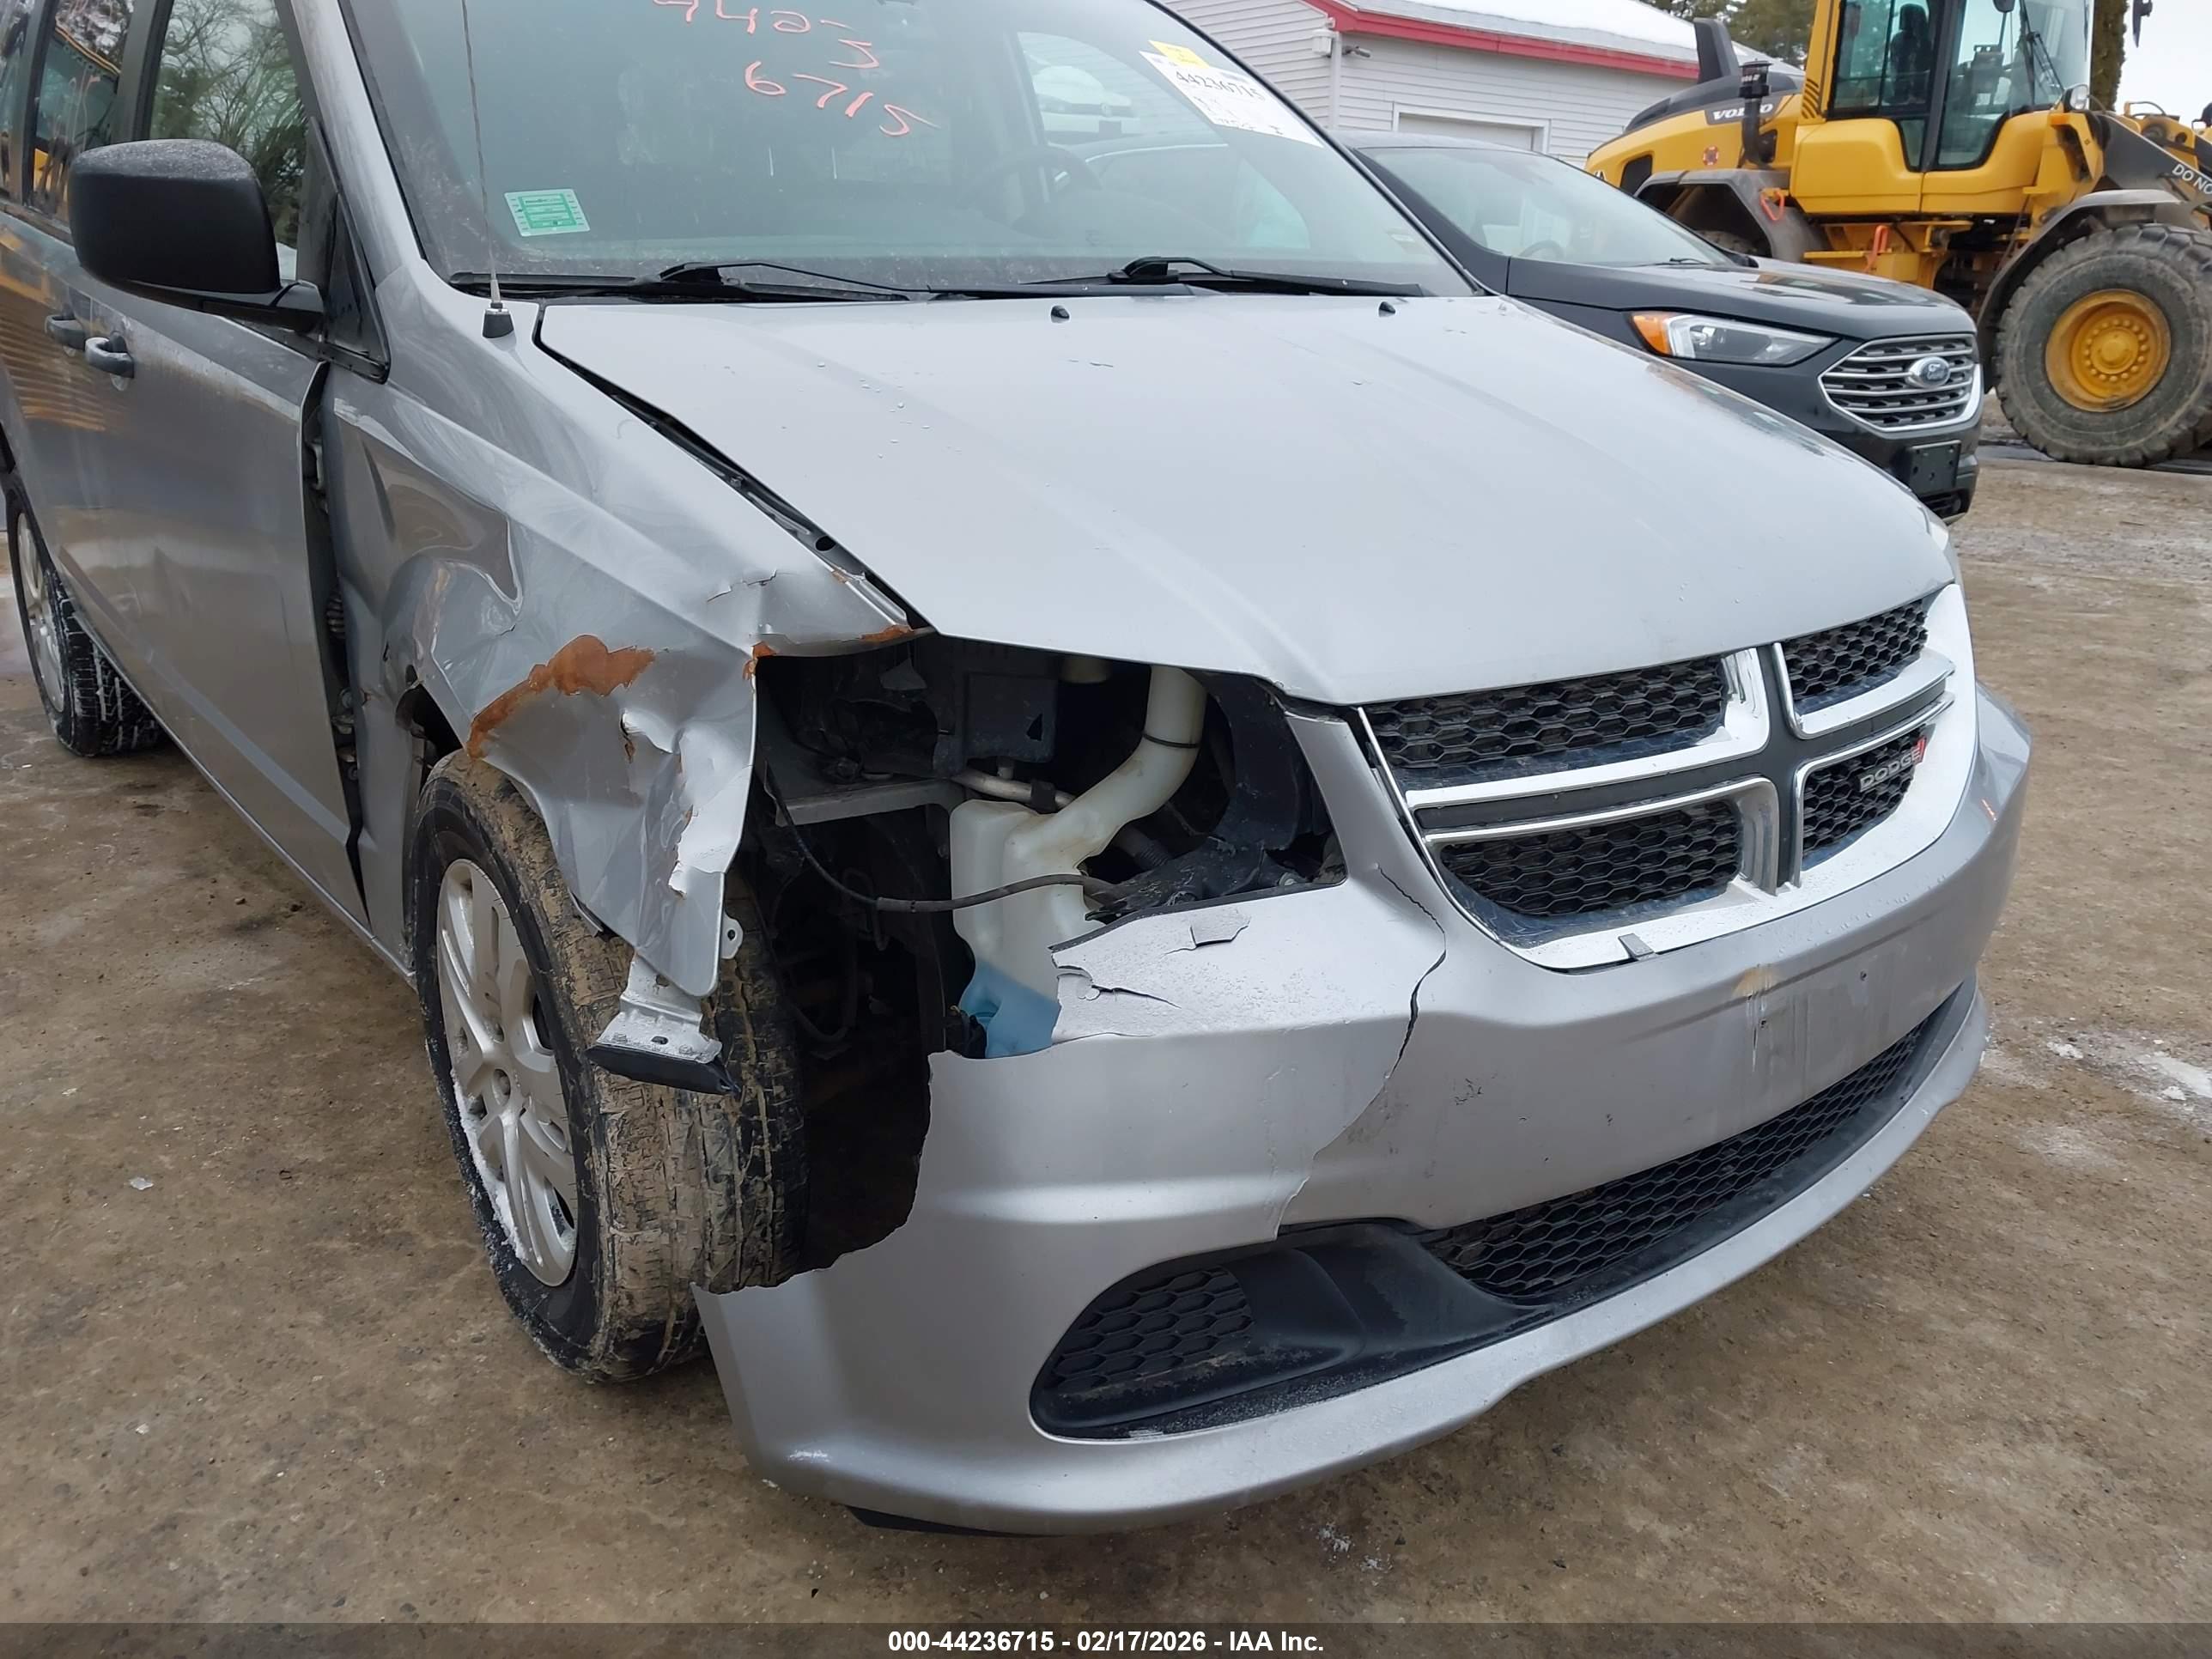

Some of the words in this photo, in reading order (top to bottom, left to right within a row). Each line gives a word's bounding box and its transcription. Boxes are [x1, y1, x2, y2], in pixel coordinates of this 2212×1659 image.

[744, 60, 941, 137] 6715
[1175, 70, 1266, 101] 44236715
[1712, 103, 1773, 120] VOLO
[2172, 163, 2194, 181] DO
[1860, 746, 1923, 793] DODGE
